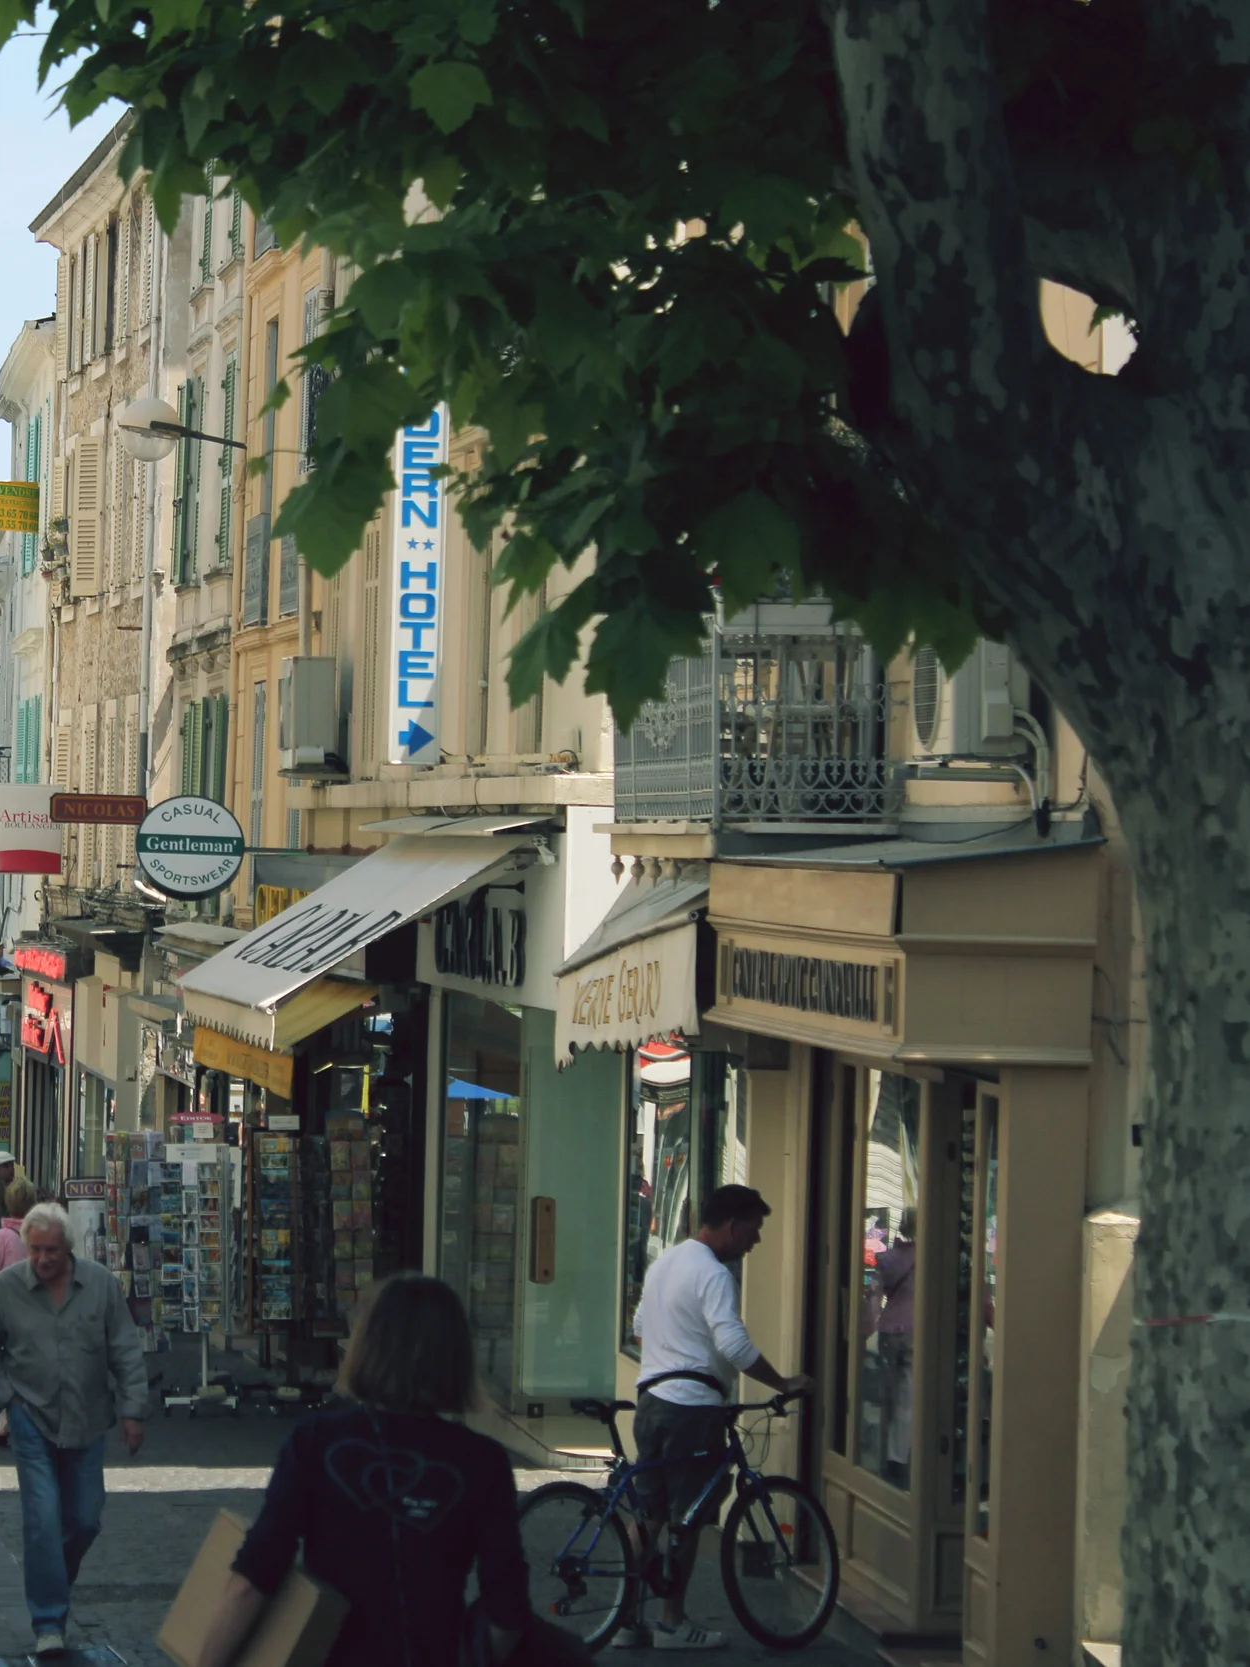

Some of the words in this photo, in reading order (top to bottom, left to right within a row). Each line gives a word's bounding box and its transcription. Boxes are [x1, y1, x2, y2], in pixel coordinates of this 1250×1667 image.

[398, 561, 437, 708] HOTEL
[0, 809, 51, 824] Artisa
[64, 802, 136, 817] NICOLAS
[161, 804, 221, 824] CASUAL
[150, 859, 234, 886] SPORTSWEAR
